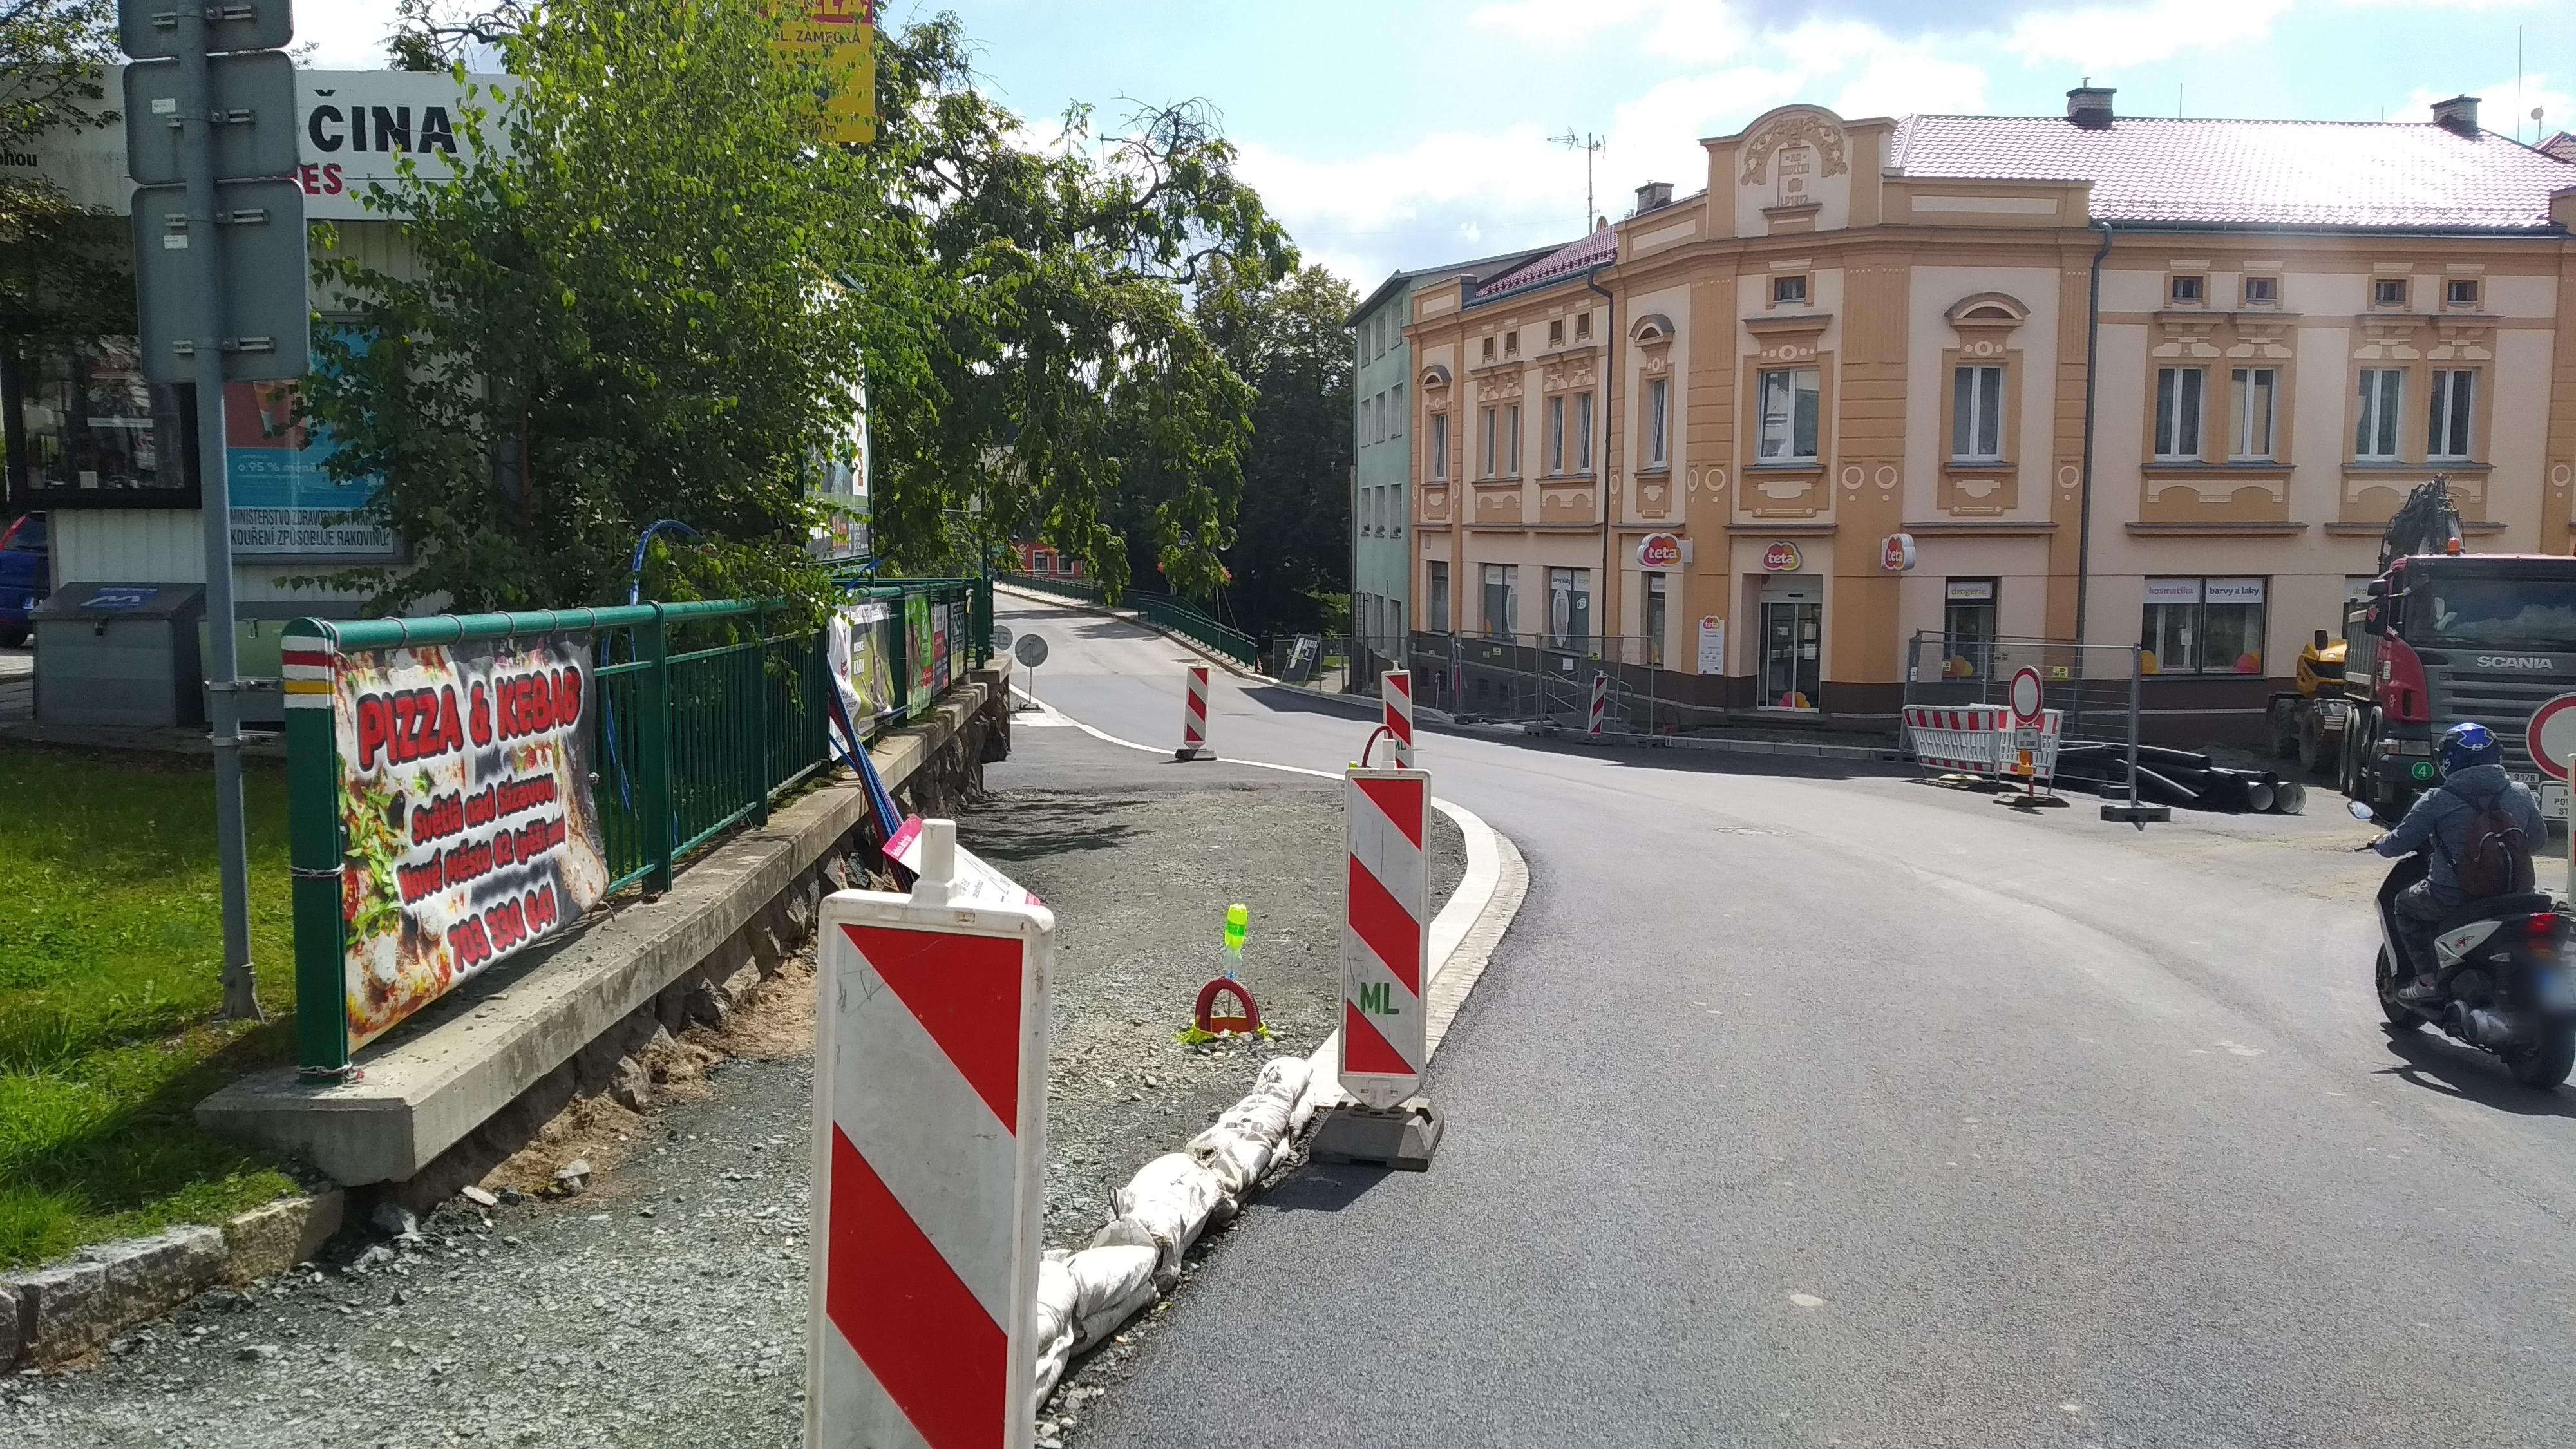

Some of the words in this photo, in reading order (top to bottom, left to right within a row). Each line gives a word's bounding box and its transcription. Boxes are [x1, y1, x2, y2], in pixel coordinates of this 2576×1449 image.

[308, 89, 458, 153] ČINA
[293, 163, 343, 195] ES
[231, 509, 290, 526] MINISTERSTVO
[231, 526, 274, 545] KOUŘENÍ
[277, 526, 334, 546] ZPŮSOBUJE
[1648, 547, 1678, 559] teta
[1768, 553, 1794, 564] teta
[1888, 548, 1903, 562] teta
[1951, 587, 1987, 597] drogerie
[2148, 586, 2193, 595] kosmetika
[2210, 586, 2234, 596] barvy
[2242, 586, 2259, 596] laky
[2477, 656, 2553, 669] SCANIA
[357, 684, 464, 772] PIZZA
[469, 680, 492, 748] &
[495, 665, 582, 741] KEBAB
[2418, 764, 2428, 777] 4
[2514, 773, 2535, 782] 9178
[412, 788, 464, 847] Světlá
[465, 782, 496, 829] nad
[396, 848, 443, 906] Nové
[444, 838, 493, 888] Město
[447, 913, 492, 973] 703
[484, 896, 527, 952] 330
[1360, 982, 1399, 1014] ML
